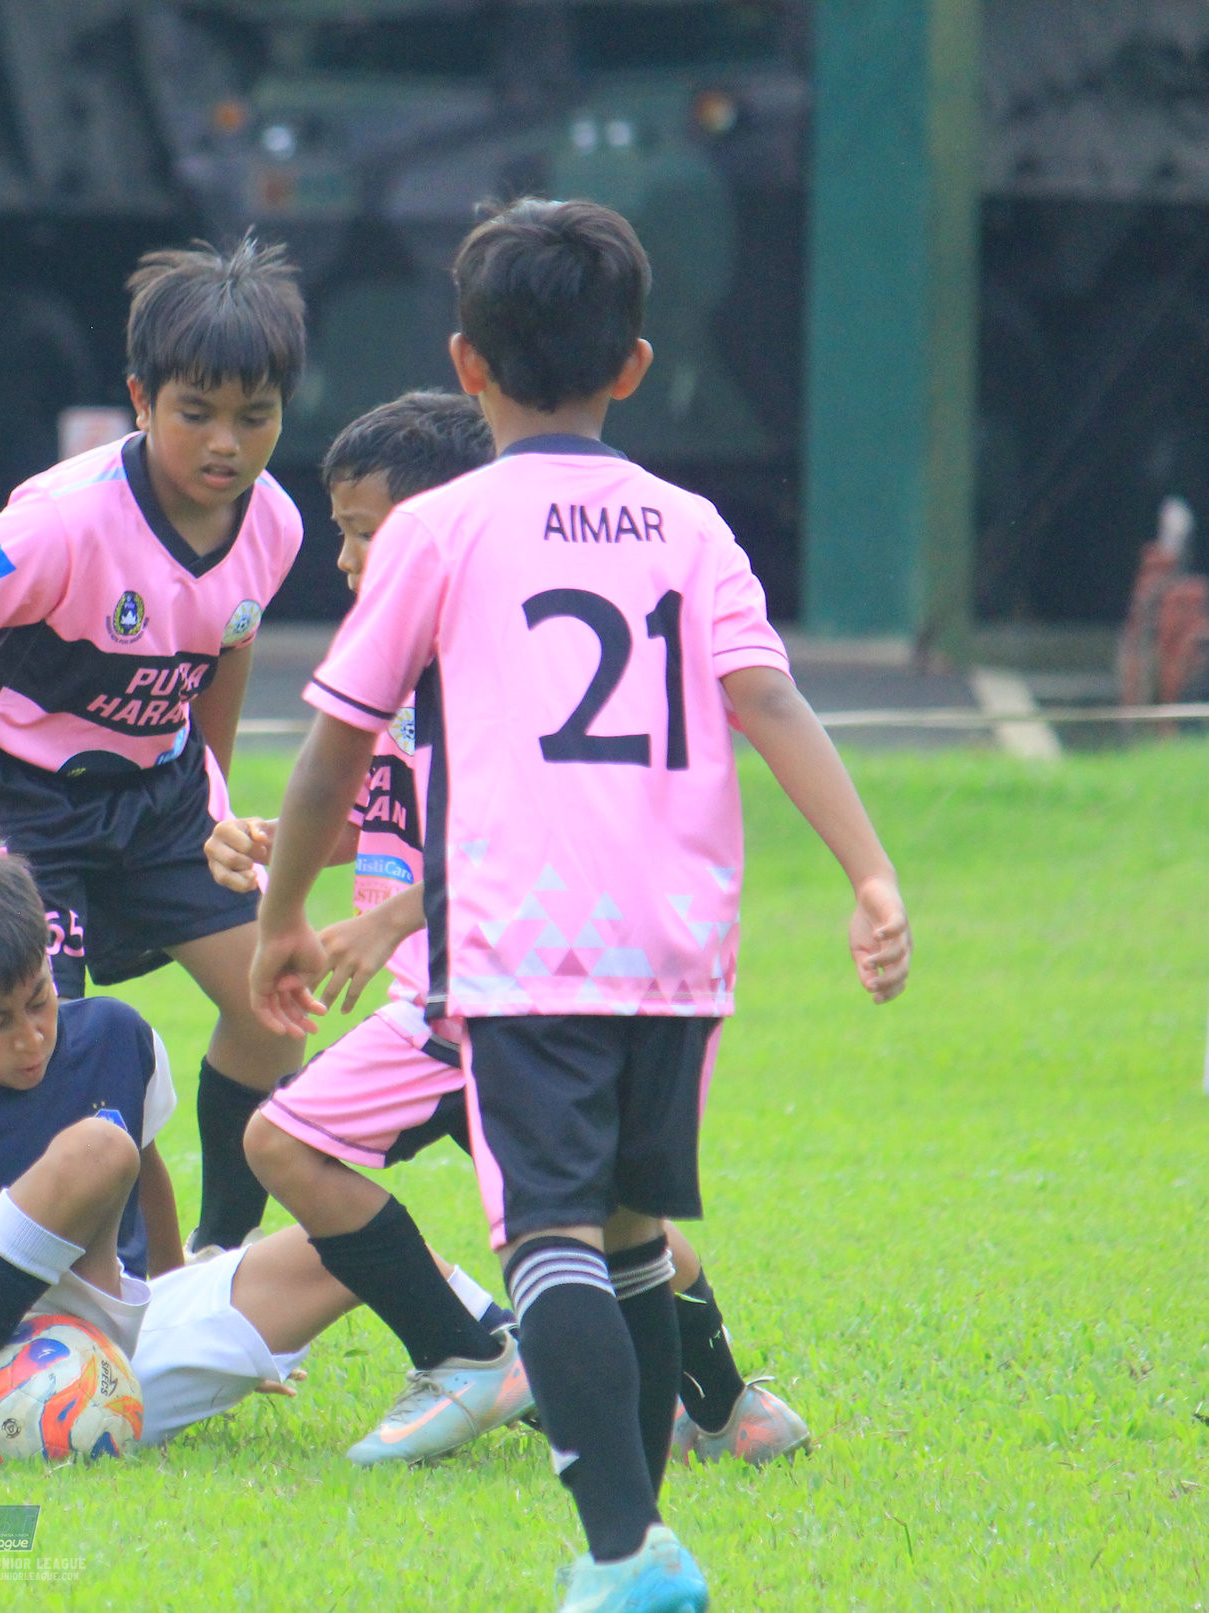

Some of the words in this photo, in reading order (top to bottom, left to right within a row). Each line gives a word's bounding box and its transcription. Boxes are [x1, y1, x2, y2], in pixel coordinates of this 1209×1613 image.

[544, 503, 666, 543] AIMAR
[521, 588, 689, 771] 21
[101, 1360, 110, 1397] SPECS
